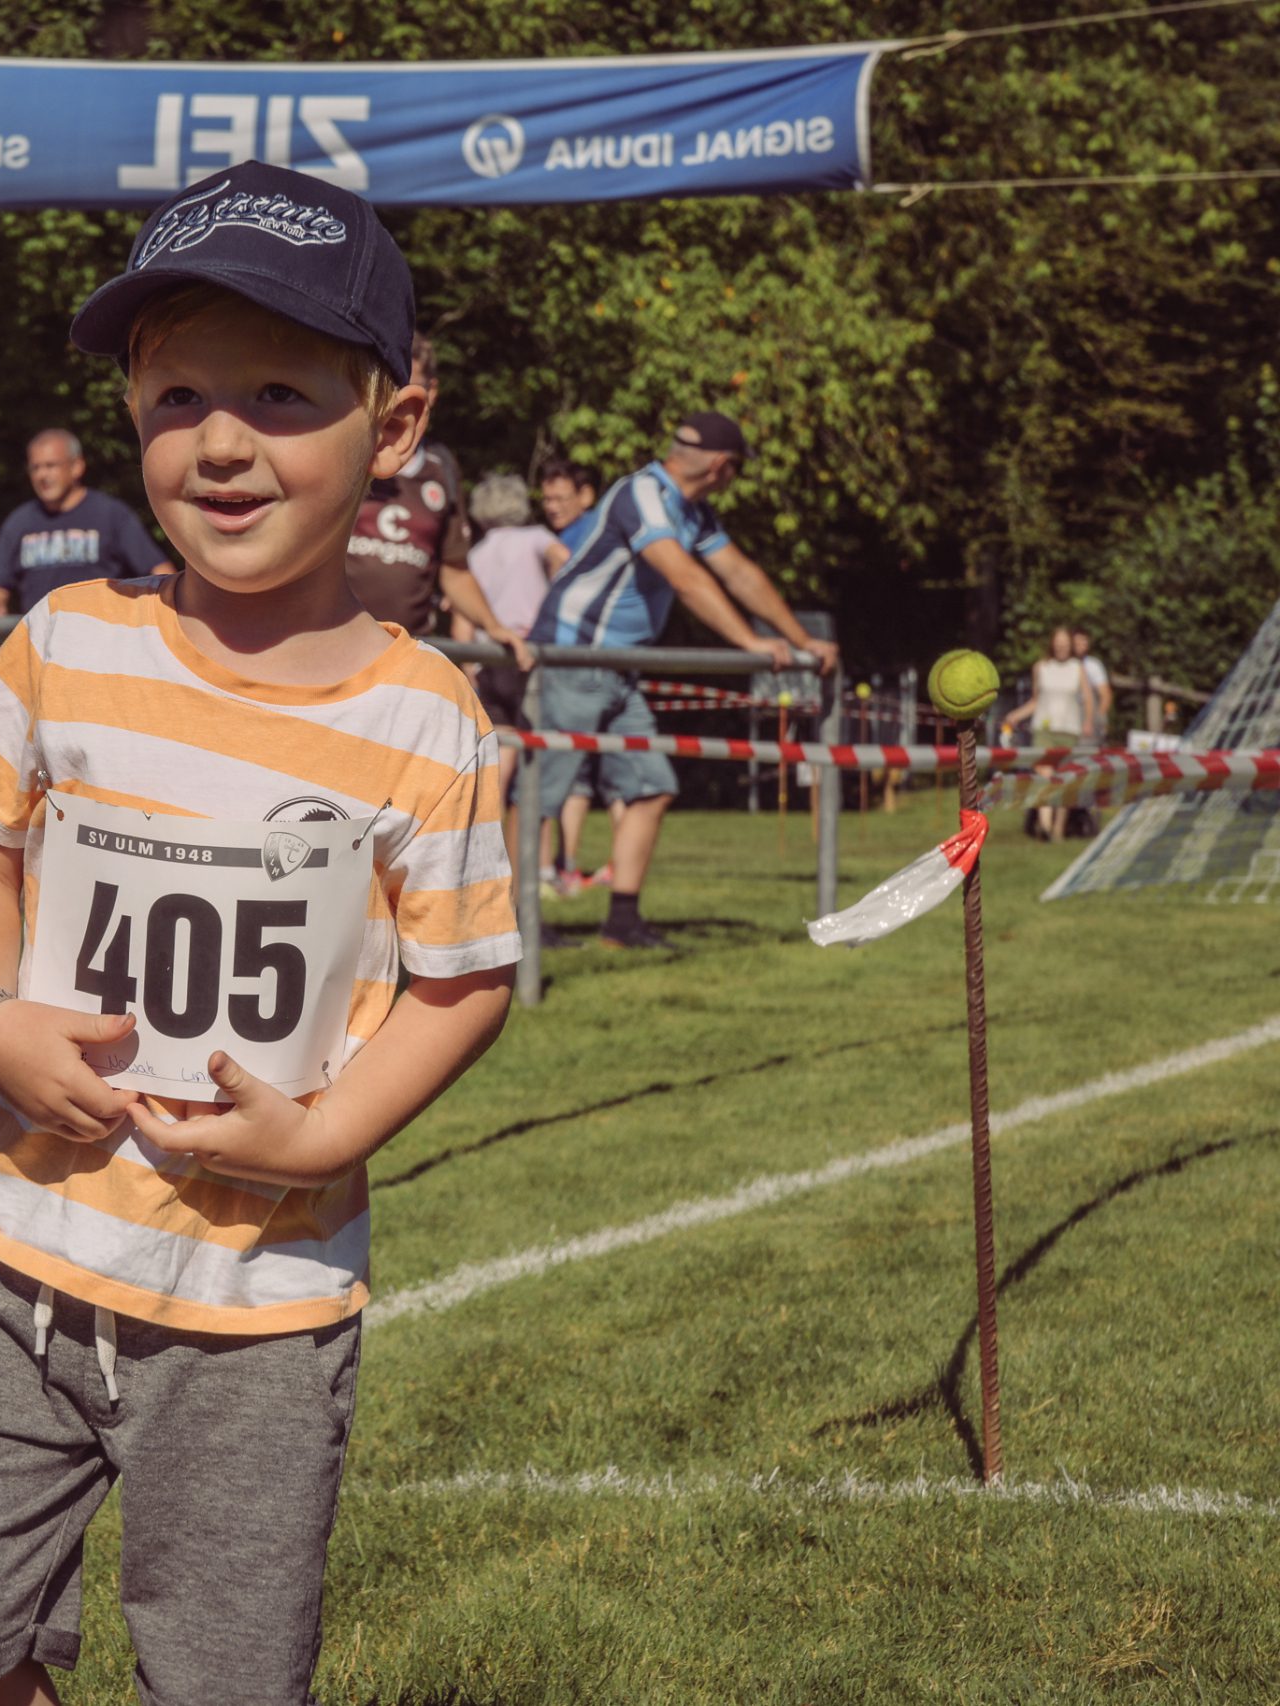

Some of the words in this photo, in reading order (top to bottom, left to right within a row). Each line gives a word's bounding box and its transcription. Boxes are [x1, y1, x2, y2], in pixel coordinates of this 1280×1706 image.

[258, 218, 281, 232] NEW
[88, 830, 107, 847] SV
[115, 838, 154, 857] ULM
[163, 845, 214, 863] 1948
[74, 880, 308, 1043] 405
